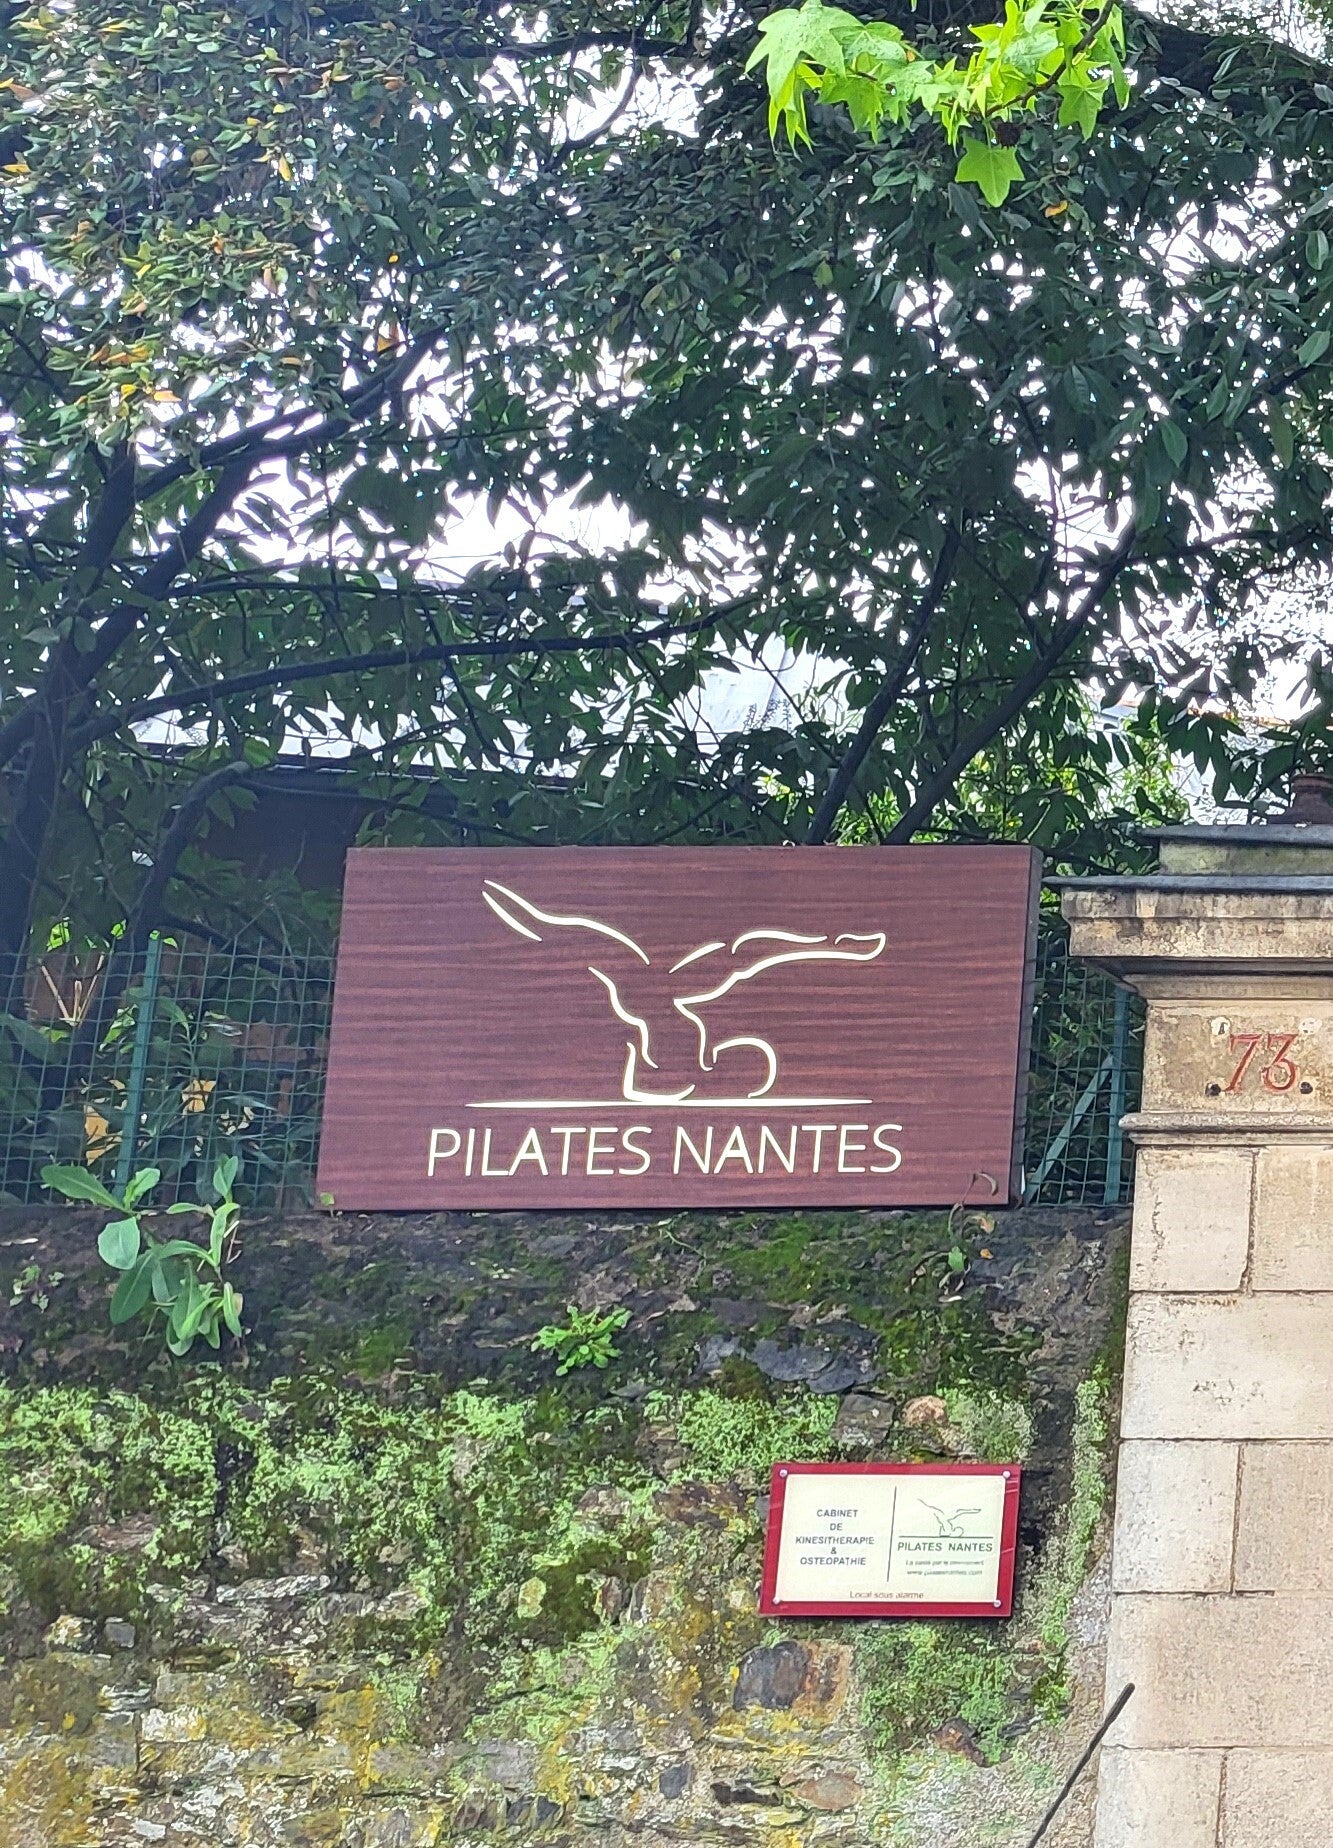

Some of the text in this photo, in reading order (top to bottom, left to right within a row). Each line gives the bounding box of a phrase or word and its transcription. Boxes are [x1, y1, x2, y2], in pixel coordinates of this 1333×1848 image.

[1222, 1032, 1300, 1094] 73
[427, 1123, 903, 1178] PILATES NANTES
[817, 1509, 858, 1517] CABINET
[829, 1523, 843, 1531] DE
[795, 1536, 875, 1545] KINESITHERAPIE
[830, 1547, 837, 1555] &
[897, 1542, 993, 1552] PILATES NANTES
[800, 1557, 867, 1565] OSTEOPATHIE
